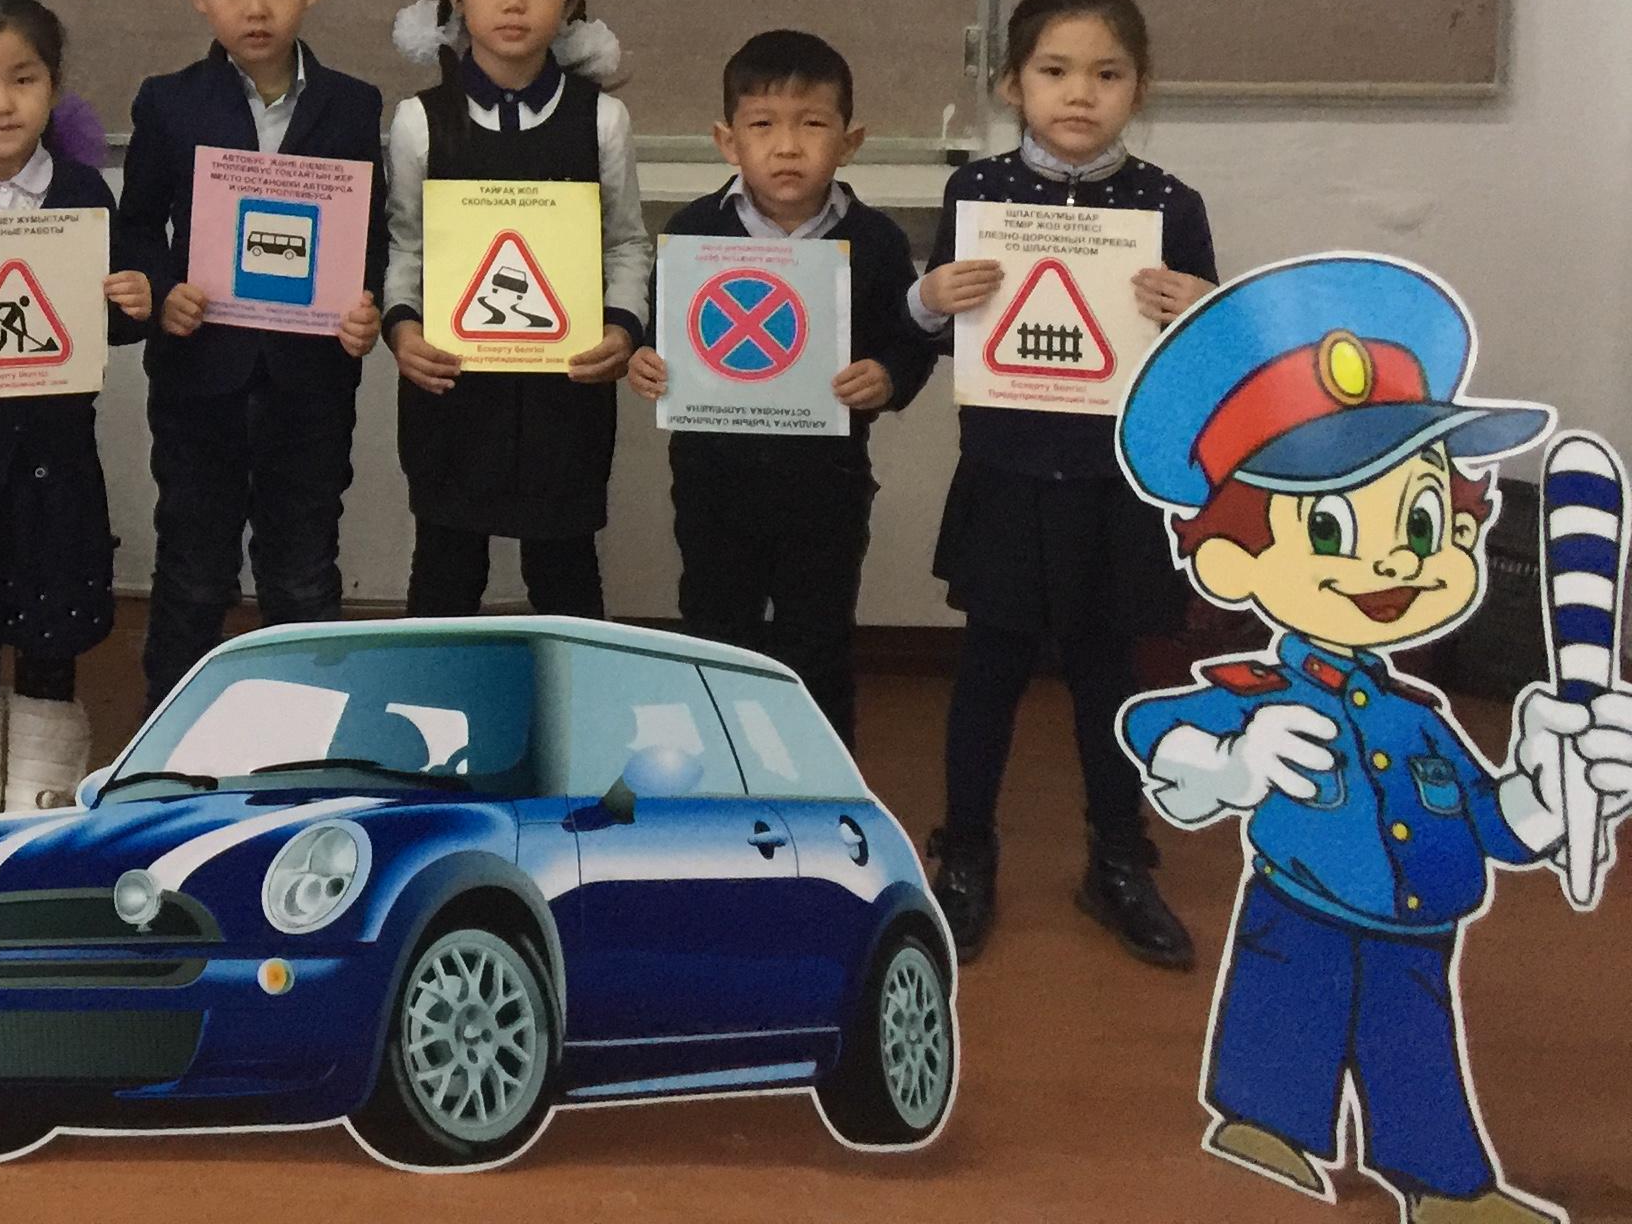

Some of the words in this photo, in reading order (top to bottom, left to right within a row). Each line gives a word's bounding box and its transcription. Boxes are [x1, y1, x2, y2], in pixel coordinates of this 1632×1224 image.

[461, 197, 517, 206] СКОЛЬЗКАЯ
[518, 198, 557, 207] ДОРОГА
[23, 226, 65, 235] РАБОТЫ
